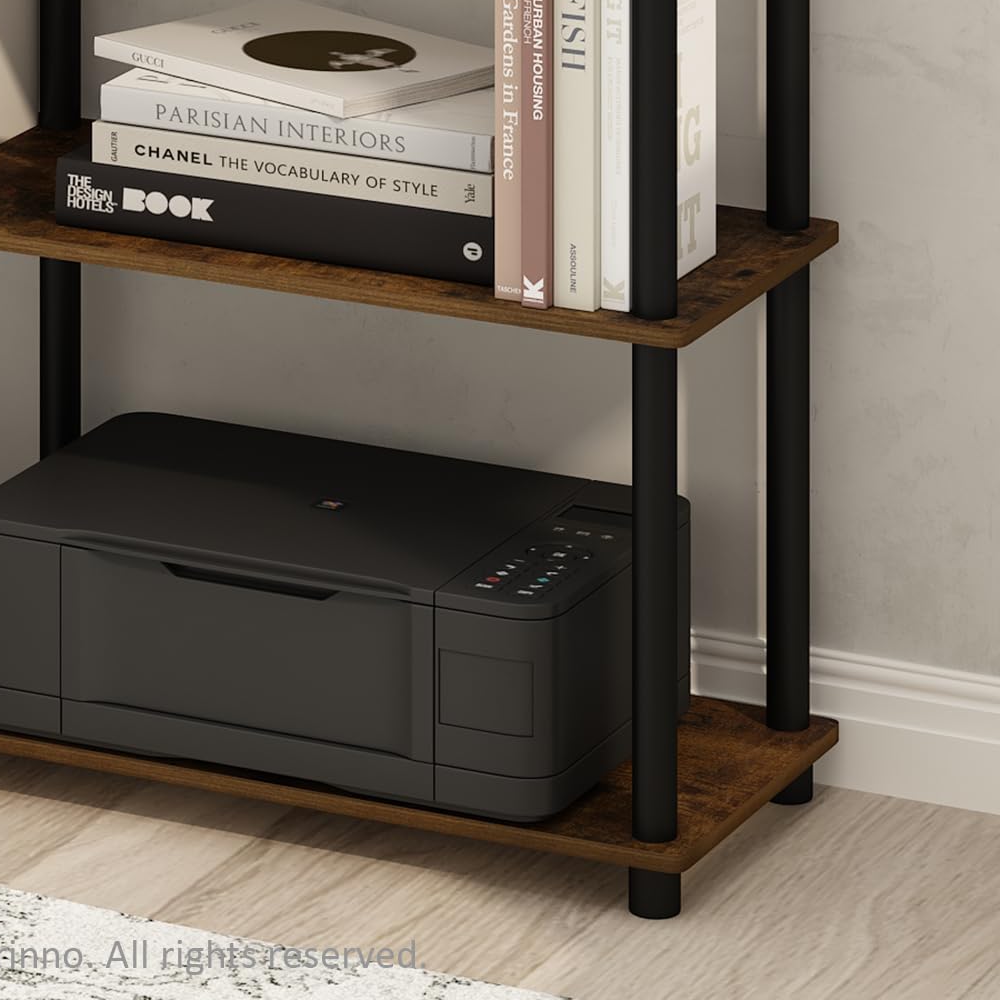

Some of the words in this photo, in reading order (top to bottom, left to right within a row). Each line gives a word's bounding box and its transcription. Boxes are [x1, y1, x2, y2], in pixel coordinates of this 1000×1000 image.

[523, 0, 532, 44] FRENCH
[606, 18, 623, 45] IT
[131, 52, 165, 68] GUCCI
[503, 82, 518, 103] in
[533, 52, 544, 121] HOUSING
[155, 104, 268, 135] PARISIAN
[278, 120, 406, 153] INTERIORS
[110, 131, 118, 162] GAUTIER
[503, 111, 518, 181] France
[67, 173, 92, 188] THE
[134, 145, 213, 166] CHANEL
[219, 156, 248, 171] THE
[254, 160, 360, 185] VOCABULARY
[366, 176, 387, 190] OF
[393, 180, 438, 198] STYLE
[66, 197, 114, 214] HOTELS
[67, 185, 113, 201] DESIGN
[122, 187, 215, 222] BOOK
[464, 183, 476, 204] Yale
